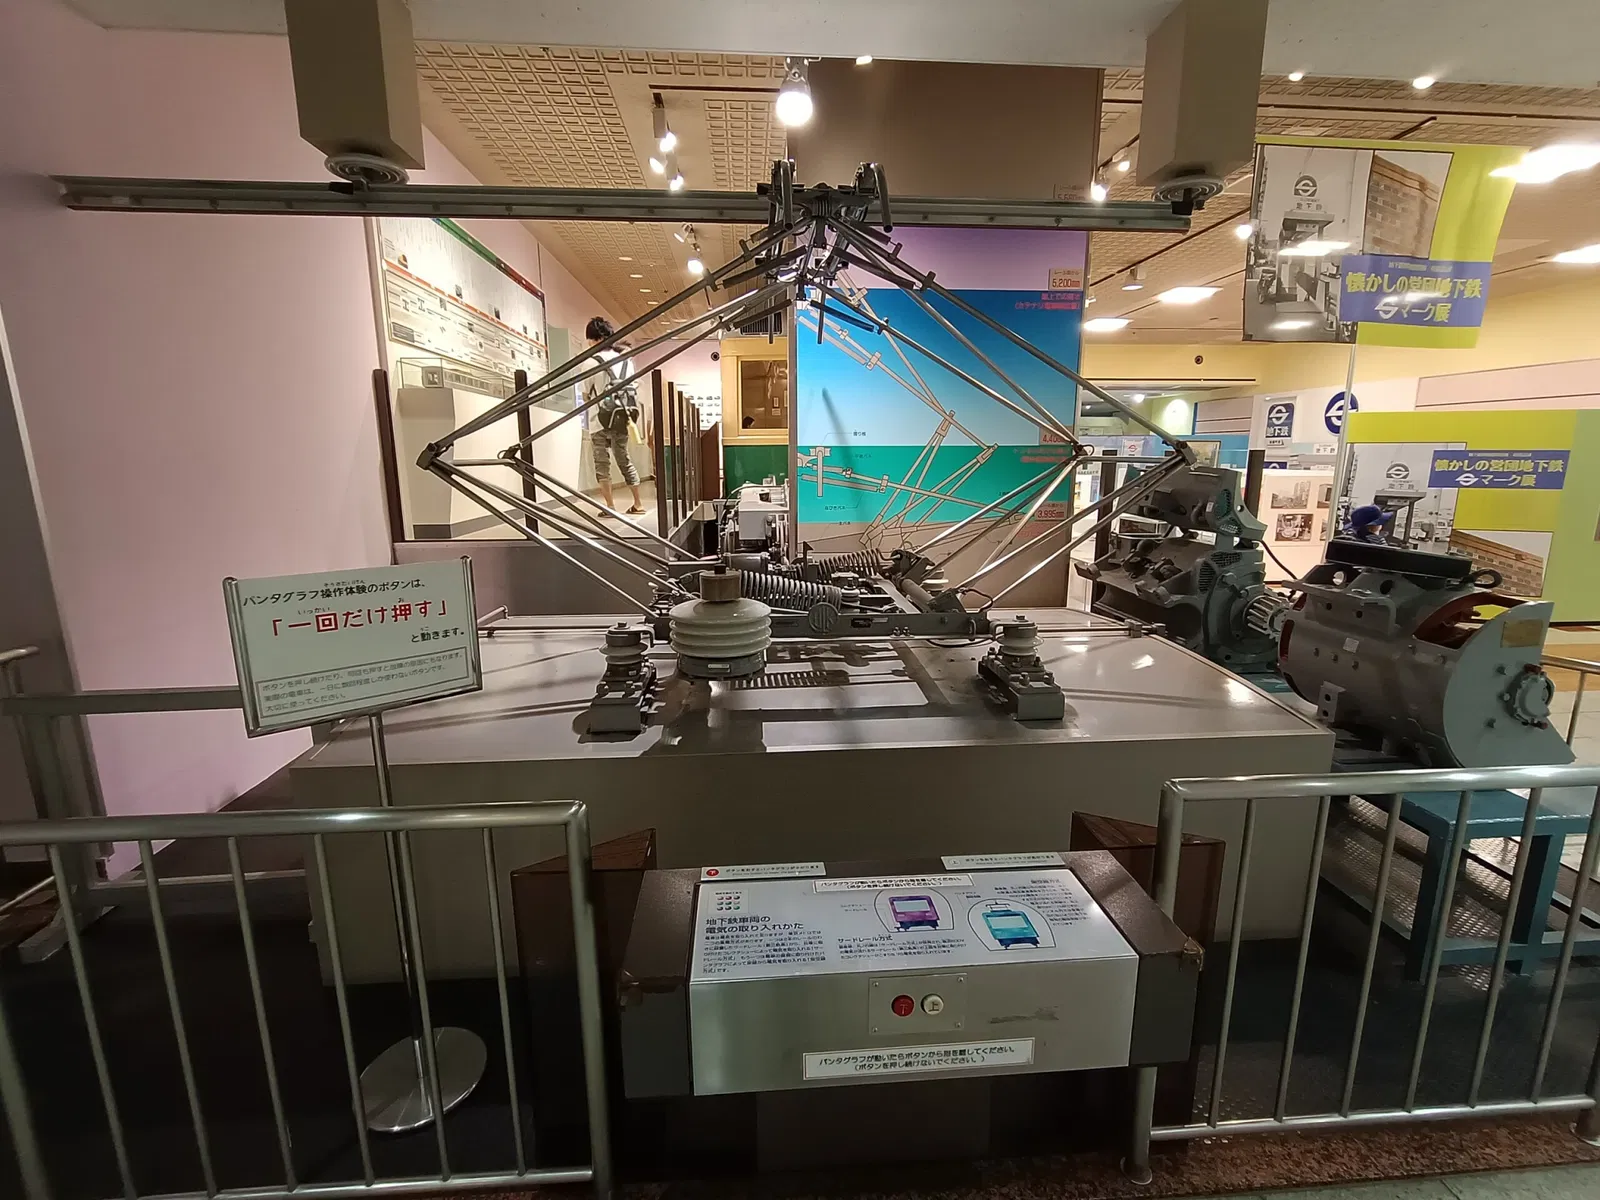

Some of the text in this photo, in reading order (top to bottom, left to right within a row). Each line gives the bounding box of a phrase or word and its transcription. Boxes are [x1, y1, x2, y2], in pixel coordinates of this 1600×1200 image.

[1435, 459, 1565, 472] 懐かしの営団地下鉄
[243, 579, 426, 606] パンタグラフ操作体験のボタンは、
[272, 600, 448, 636] 「一回だけ押す」
[410, 627, 465, 644] と動きます。
[706, 916, 771, 926] 地下鉄車両の
[705, 922, 804, 934] 電気の取り入れかた
[928, 1001, 940, 1012] 上
